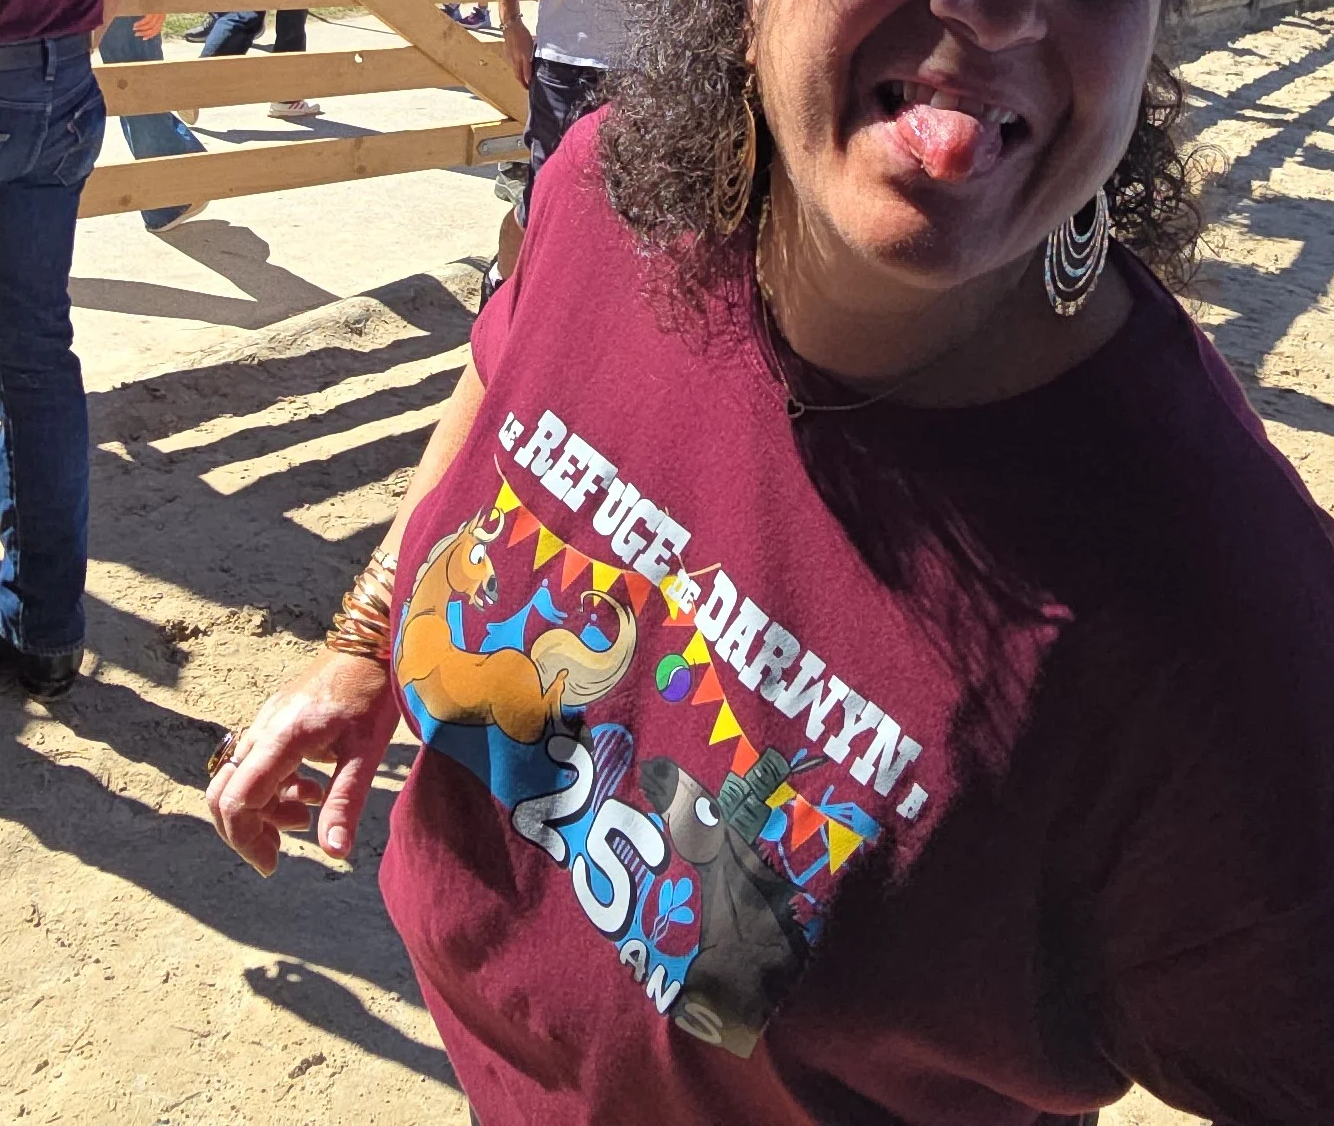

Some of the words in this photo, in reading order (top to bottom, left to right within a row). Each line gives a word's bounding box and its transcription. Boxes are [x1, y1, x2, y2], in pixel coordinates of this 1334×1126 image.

[499, 411, 525, 451] LE
[513, 409, 692, 578] REFUGE
[669, 571, 702, 616] DE
[694, 571, 924, 798] DARWYN
[512, 733, 665, 936] 25
[619, 941, 723, 1046] ANS
